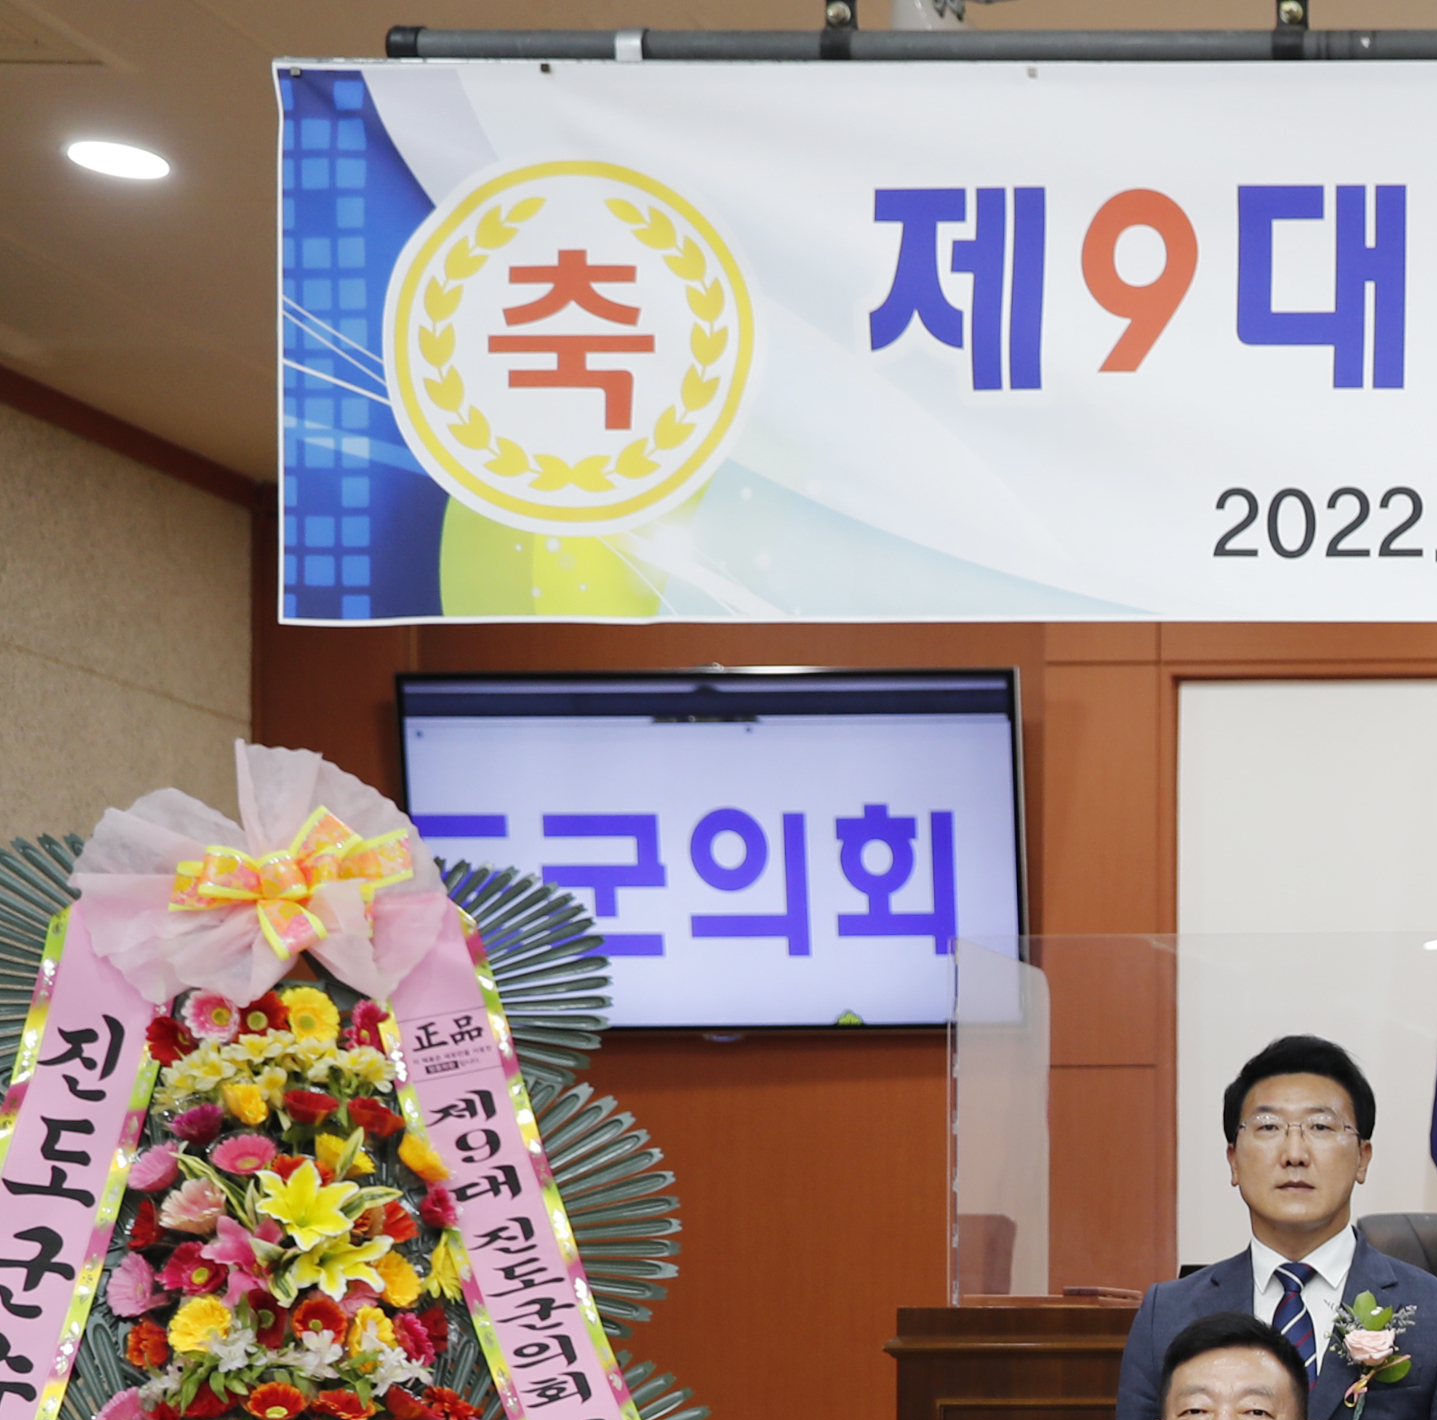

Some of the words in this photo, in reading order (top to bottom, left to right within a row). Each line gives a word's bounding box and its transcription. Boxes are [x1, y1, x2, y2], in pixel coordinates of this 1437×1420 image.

[488, 249, 656, 431] 축
[868, 184, 1408, 393] 제9대
[412, 1015, 484, 1053] 正品
[426, 1089, 522, 1202] 제9대
[468, 1216, 592, 1409] 진도군의회
